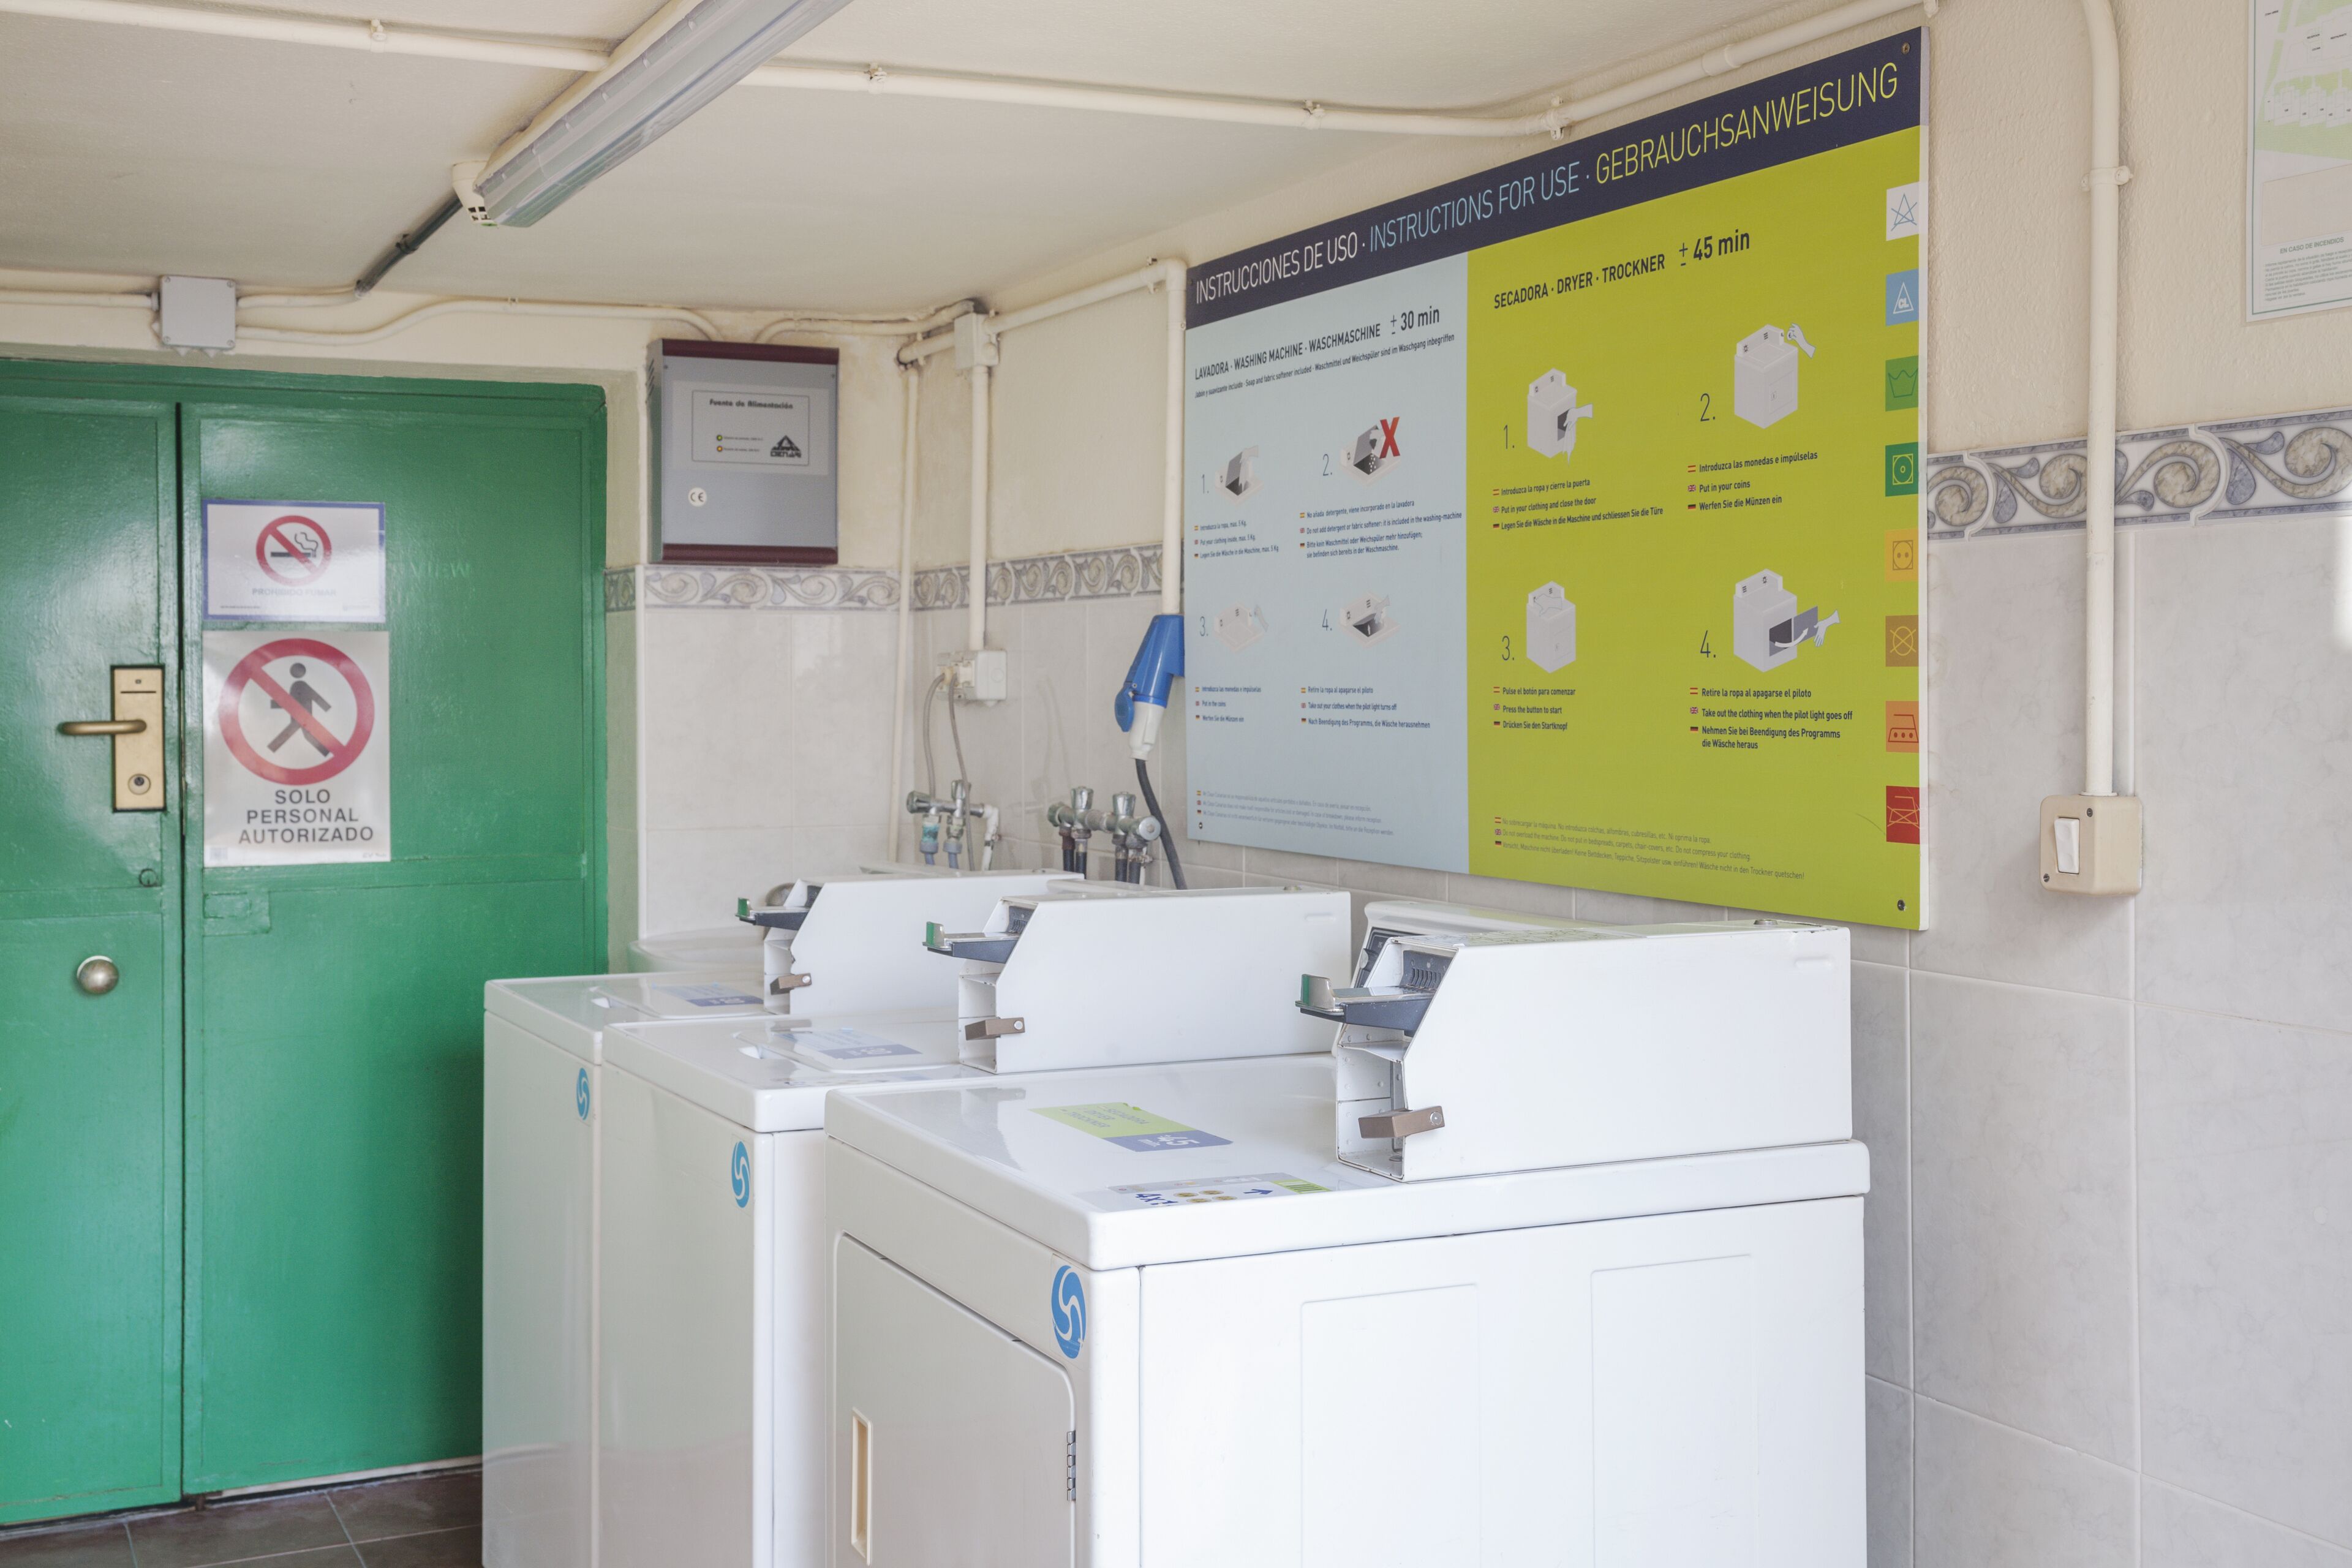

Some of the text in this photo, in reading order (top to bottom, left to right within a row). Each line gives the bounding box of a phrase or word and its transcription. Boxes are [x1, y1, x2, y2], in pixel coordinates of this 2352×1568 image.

[1196, 62, 1898, 304] INSTRUCCIONES DE USO INSTRUCTIONS FOR USE GEBRAUCHSANWEISUNG
[2313, 236, 2344, 247] INCENDIOS
[1494, 283, 1548, 308] SECADORA
[1557, 271, 1593, 293] DRYER
[1602, 254, 1665, 282] TROCKNER
[1693, 235, 1713, 260] 45
[1718, 228, 1749, 256] min
[1195, 361, 1229, 380] LAVADORA
[1234, 352, 1267, 369] WASHING
[1268, 342, 1303, 361] MACHINE
[1308, 323, 1381, 352] WASCHMASCHINE
[1400, 312, 1414, 331] 30
[1418, 306, 1439, 328] min
[1294, 366, 1312, 375] included
[1314, 359, 1342, 371] Waschmittel
[1342, 356, 1351, 365] und
[1351, 351, 1380, 363] Weichspüler
[1381, 347, 1391, 357] sind
[1398, 341, 1426, 352] Waschgang
[1427, 334, 1455, 346] inbegriffen
[709, 398, 733, 407] Fuente
[1700, 393, 1716, 422] 2.
[1503, 424, 1515, 450] 1.
[1322, 453, 1333, 477] 2.
[1700, 462, 1732, 472] Introduzca
[1733, 460, 1743, 469] las
[1744, 457, 1774, 467] monedas
[1781, 452, 1818, 464] impúlselas
[1501, 487, 1527, 496] Introduzca
[1572, 479, 1590, 489] puerta
[1699, 480, 1751, 493] Put in your coins
[1516, 505, 1528, 514] your
[1528, 503, 1548, 511] clothing
[1549, 500, 1559, 509] and
[1699, 495, 1782, 510] Werfen Sie die Münzen ein
[1501, 522, 1516, 531] Legen
[1567, 514, 1591, 523] Maschine
[1591, 513, 1602, 521] und
[1602, 511, 1630, 520] schliessen
[1631, 509, 1640, 518] Sie
[1650, 507, 1664, 515] Türe
[1322, 609, 1332, 631] 4.
[1501, 636, 1515, 661] 3.
[1700, 630, 1716, 658] 4.
[1702, 688, 1812, 699] Retire la ropa al apagarse el piloto
[1318, 718, 1341, 727] Beendigung
[1349, 719, 1374, 728] Programms,
[1702, 708, 1716, 717] Take
[1727, 709, 1738, 718] the
[1738, 709, 1763, 720] clothing
[1764, 710, 1782, 718] when
[1782, 710, 1793, 719] the
[1794, 710, 1809, 720] pilot
[1810, 710, 1825, 721] light
[1826, 712, 1842, 722] goes
[1843, 710, 1853, 720] off
[1503, 720, 1523, 729] Drücken
[1542, 722, 1568, 731] Startknopf
[1702, 726, 1841, 740] Nehmen Sie bei Beendigung des Programms
[1702, 739, 1758, 749] die Wäsche heraus
[274, 789, 331, 804] SOLO
[246, 808, 359, 824] PERSONAL
[238, 827, 374, 844] AUTORIZADO
